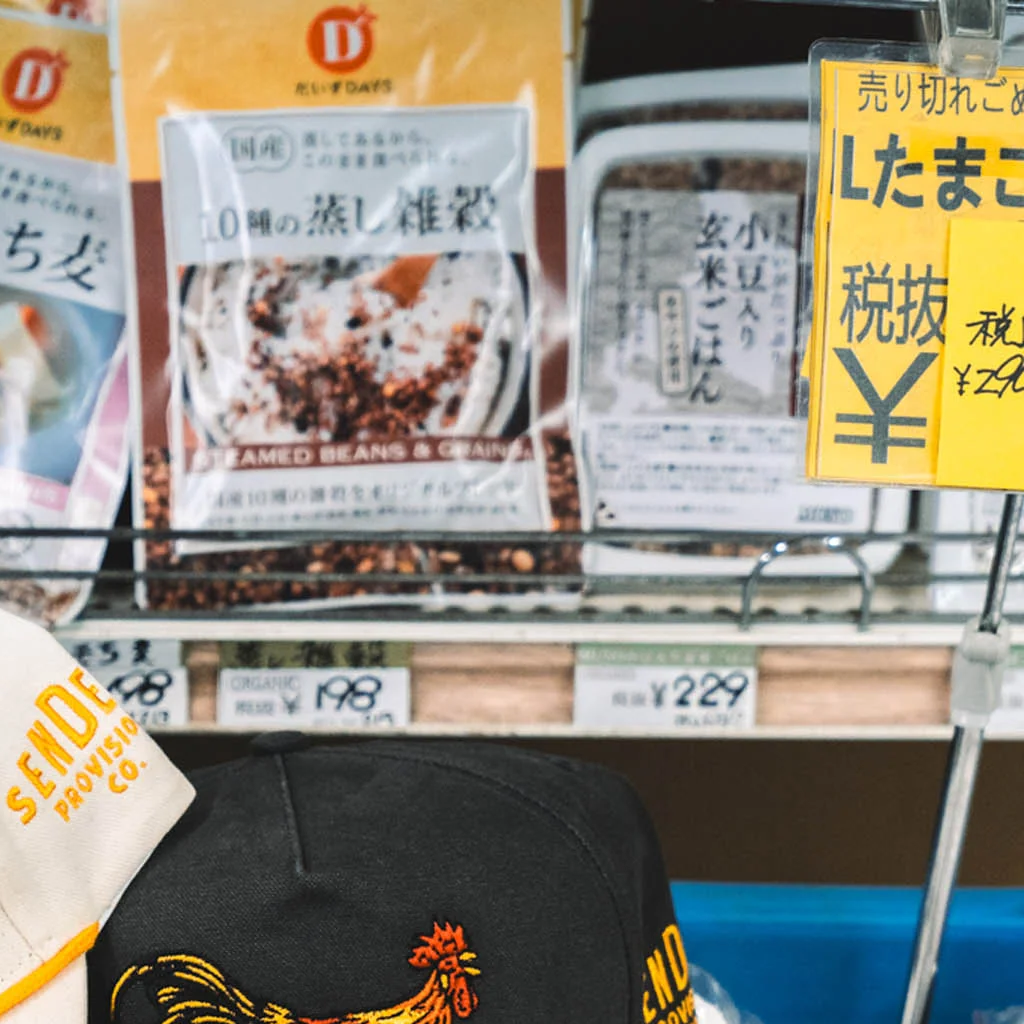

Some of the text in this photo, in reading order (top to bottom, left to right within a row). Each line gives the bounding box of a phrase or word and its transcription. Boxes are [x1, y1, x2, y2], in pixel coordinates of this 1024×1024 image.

[323, 19, 363, 63] D
[840, 263, 947, 346] 税抜
[966, 303, 1024, 348] 税
[320, 442, 405, 464] BEANS
[315, 674, 382, 712] 198
[674, 671, 749, 708] 229
[108, 760, 147, 794] CO.
